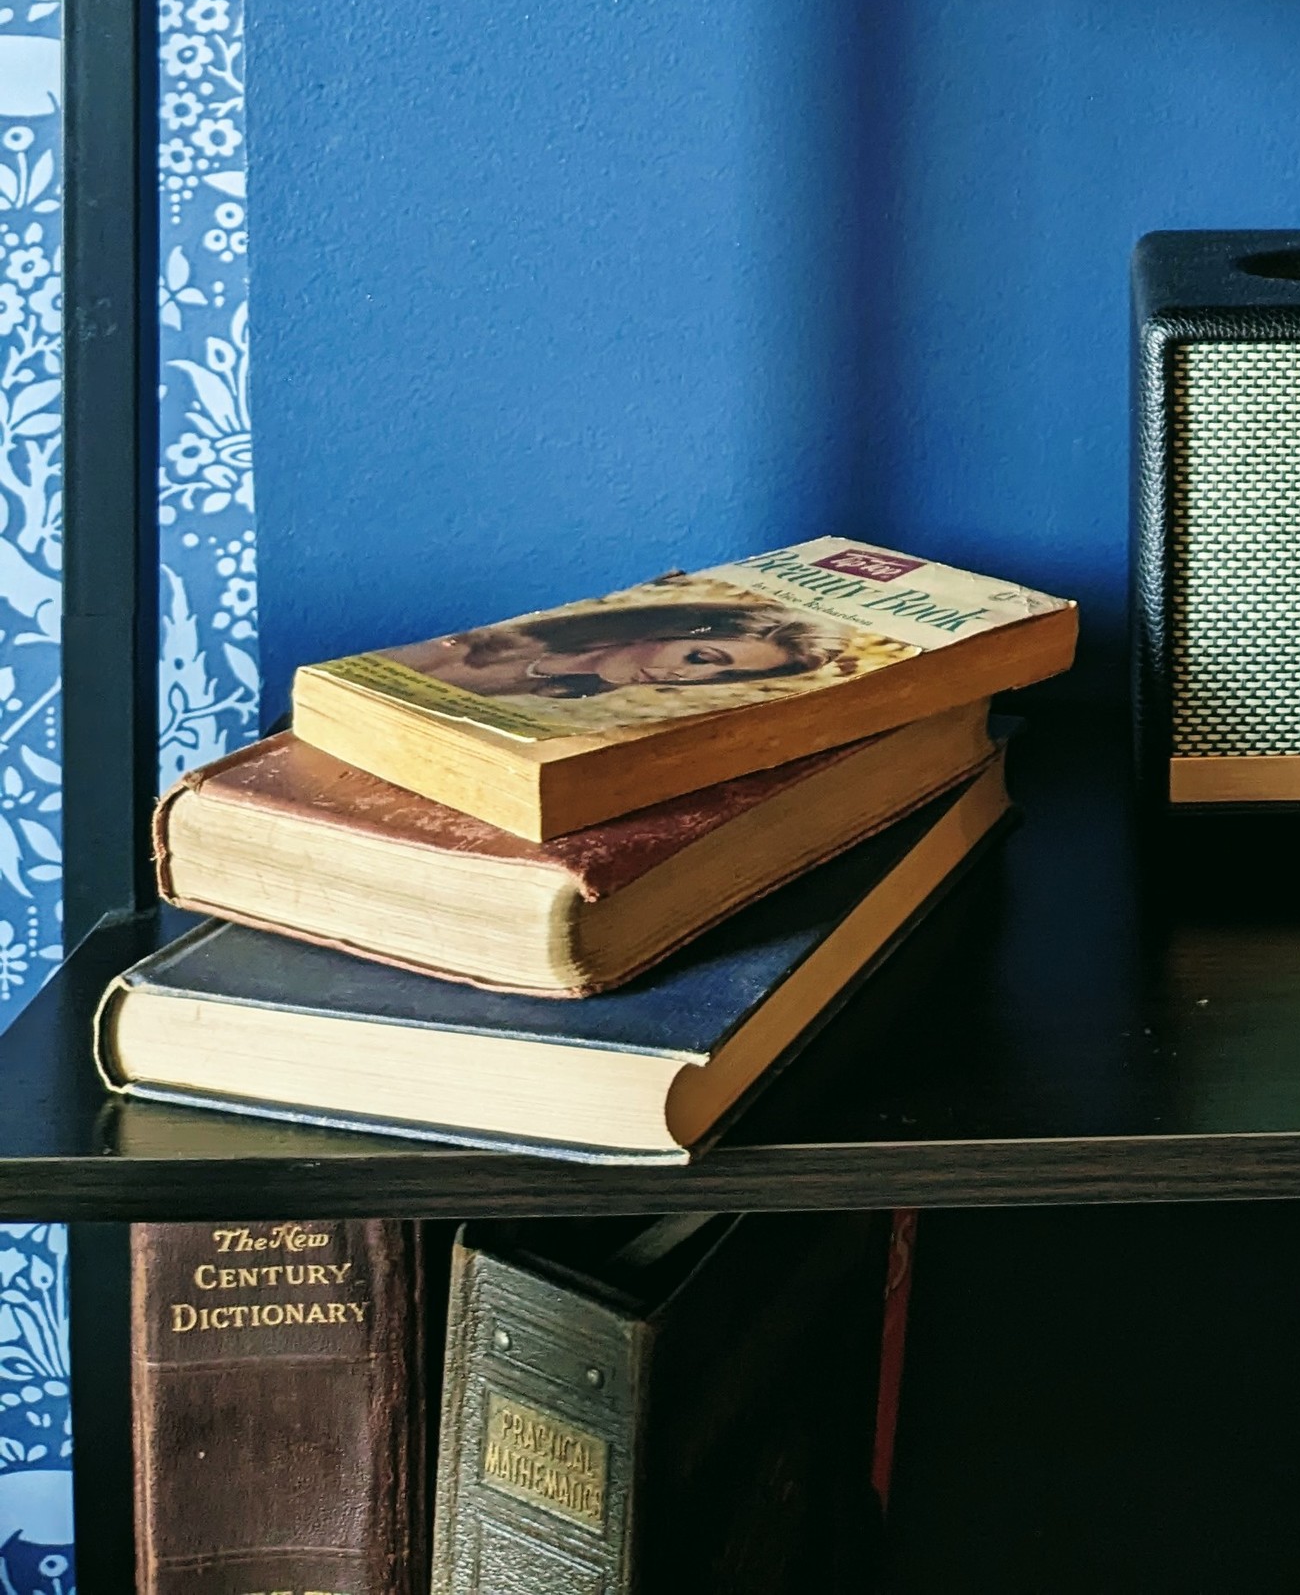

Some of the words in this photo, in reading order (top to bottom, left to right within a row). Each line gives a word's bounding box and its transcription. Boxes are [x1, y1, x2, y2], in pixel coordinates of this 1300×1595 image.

[732, 551, 881, 600] Beauty
[860, 588, 991, 633] Book
[802, 599, 875, 627] Richardson
[212, 1226, 268, 1253] The
[268, 1222, 330, 1252] New
[194, 1262, 352, 1290] CENTURY
[170, 1300, 370, 1333] DICTIONARY
[500, 1408, 595, 1478] PRACTICAL
[484, 1441, 602, 1522] MATHEMATICS
